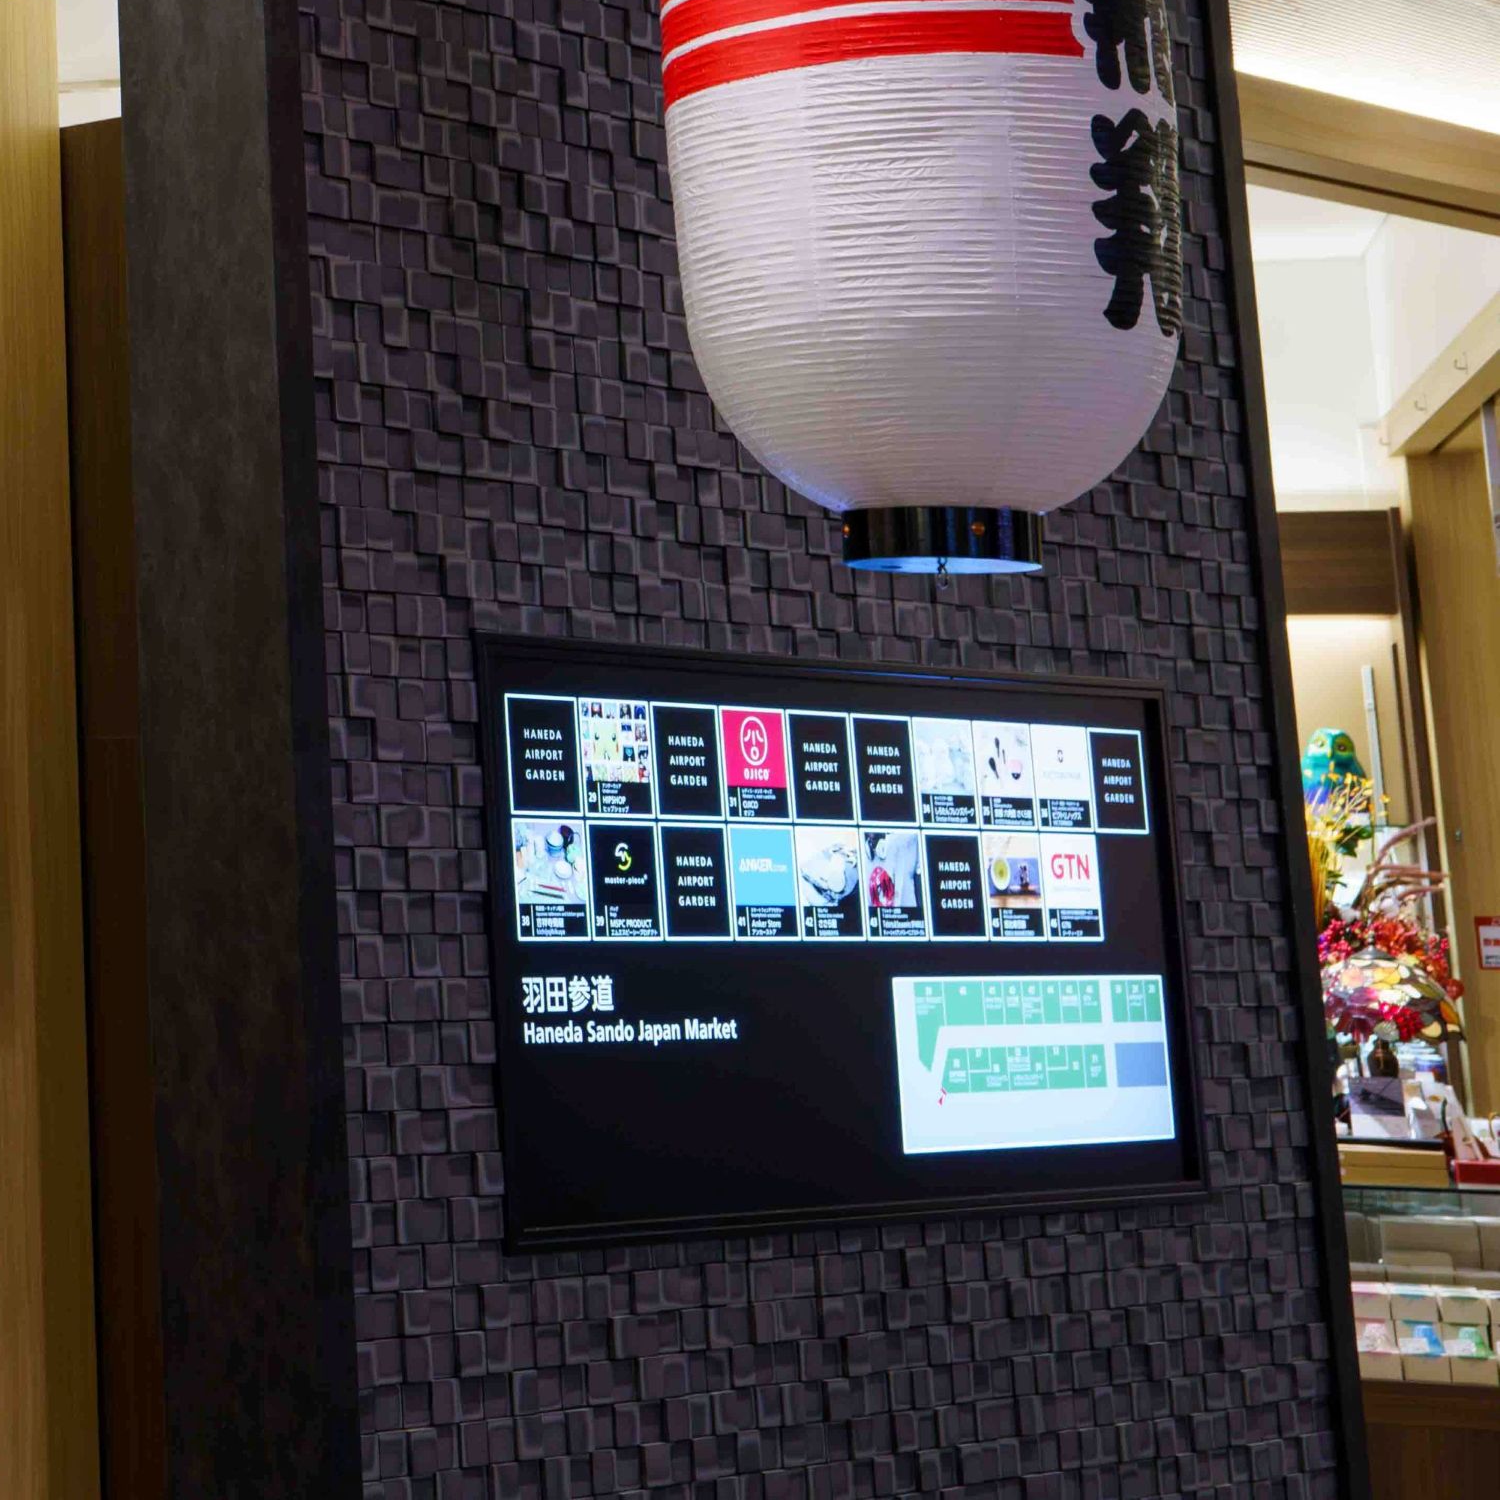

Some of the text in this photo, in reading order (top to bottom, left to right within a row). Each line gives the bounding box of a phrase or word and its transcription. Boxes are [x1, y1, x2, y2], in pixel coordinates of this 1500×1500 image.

[523, 728, 563, 741] HANEDA
[668, 735, 705, 747] HANEDA
[803, 742, 837, 754] HANEDA
[866, 745, 900, 757] HANEDA
[525, 748, 563, 761] AIRPORT
[669, 755, 706, 767] AIRPORT
[804, 761, 839, 773] AIRPORT
[1102, 757, 1131, 769] HANEDA
[525, 768, 565, 781] GARDEN
[743, 767, 769, 781] OJICO
[868, 764, 901, 776] AIRPORT
[670, 774, 708, 787] GARDEN
[805, 780, 841, 792] GARDEN
[1103, 775, 1132, 787] AIRPORT
[869, 782, 904, 794] GARDEN
[588, 791, 597, 803] 29
[602, 795, 627, 805] HIPSHOP
[1104, 792, 1135, 804] GARDEN
[676, 856, 713, 867] HANEDA
[738, 858, 773, 873] ANKER
[938, 861, 971, 873] HANEDA
[1050, 853, 1090, 881] GTN
[677, 875, 714, 887] AIRPORT
[940, 880, 972, 891] AIRPORT
[678, 895, 717, 907] GARDEN
[941, 898, 974, 910] GARDEN
[521, 915, 530, 927] 38
[626, 918, 653, 929] PRODUCT
[751, 919, 782, 928] Anker Store
[521, 975, 615, 1014] 羽田参道
[523, 1016, 738, 1046] Haneda Sando Japan Market
